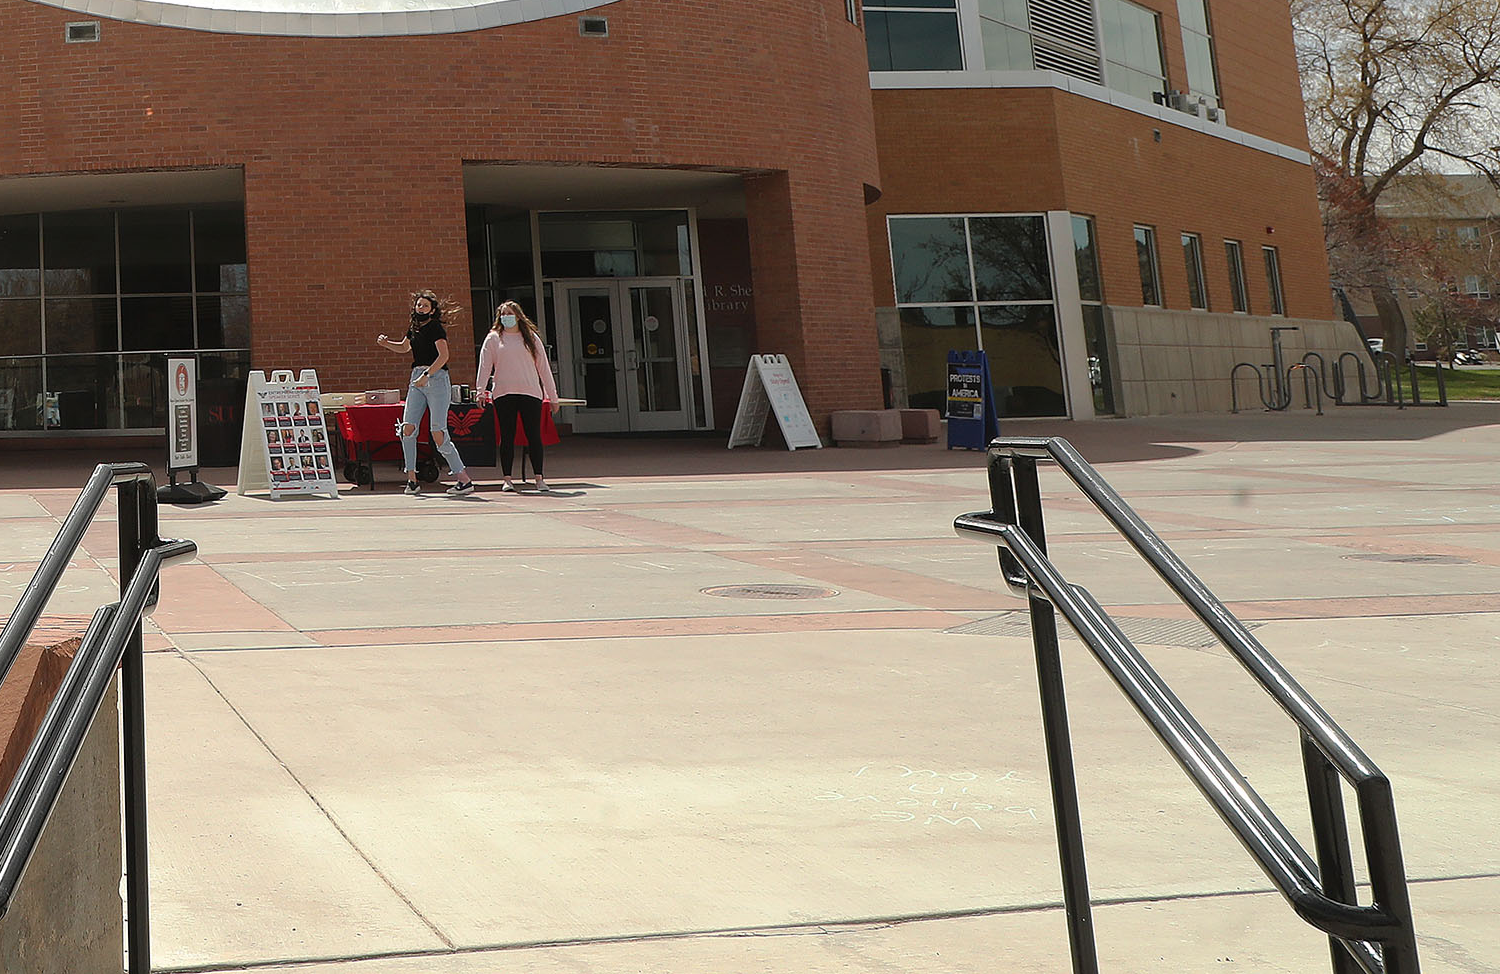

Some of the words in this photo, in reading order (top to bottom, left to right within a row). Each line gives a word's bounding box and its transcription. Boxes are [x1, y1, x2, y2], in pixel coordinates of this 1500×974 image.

[706, 298, 749, 313] ibrary
[949, 374, 981, 383] PROTESTS
[951, 389, 979, 398] AMERICA
